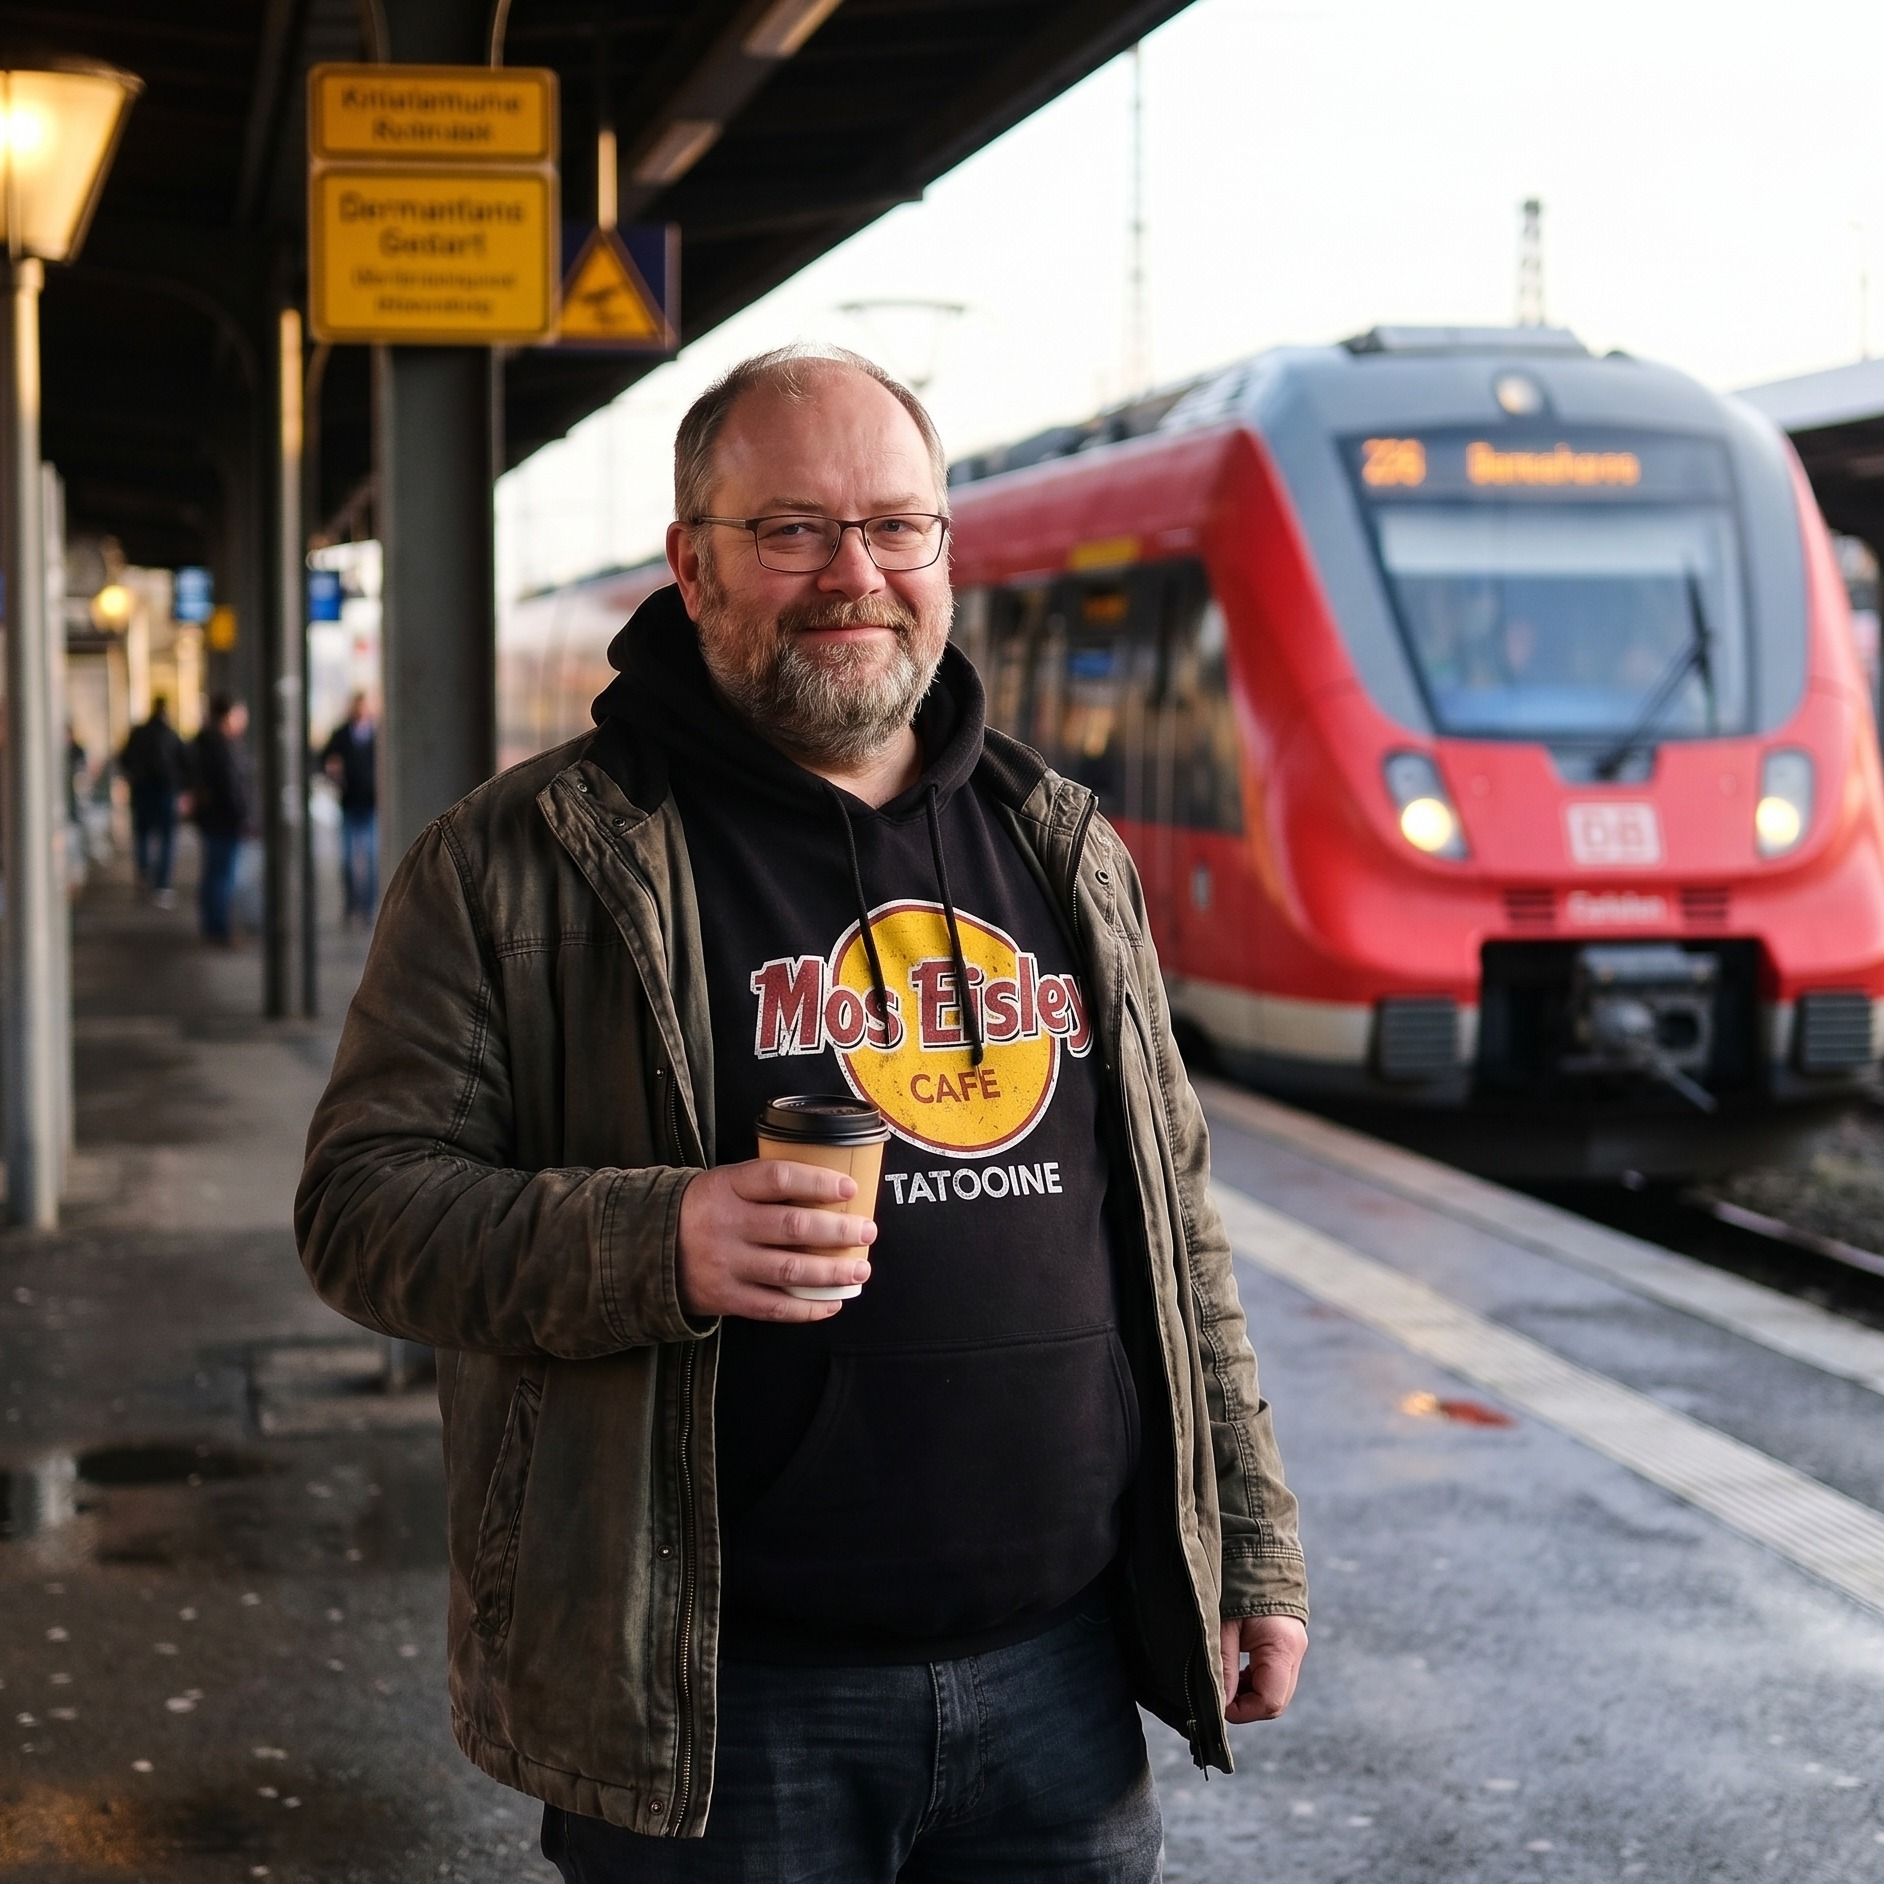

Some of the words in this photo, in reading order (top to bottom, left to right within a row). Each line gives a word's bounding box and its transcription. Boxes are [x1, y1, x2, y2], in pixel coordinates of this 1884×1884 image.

[751, 955, 905, 1059] Mos
[909, 952, 1093, 1058] Eisley
[910, 1069, 1001, 1104] CAFE
[885, 1162, 1063, 1204] TATOOINE
